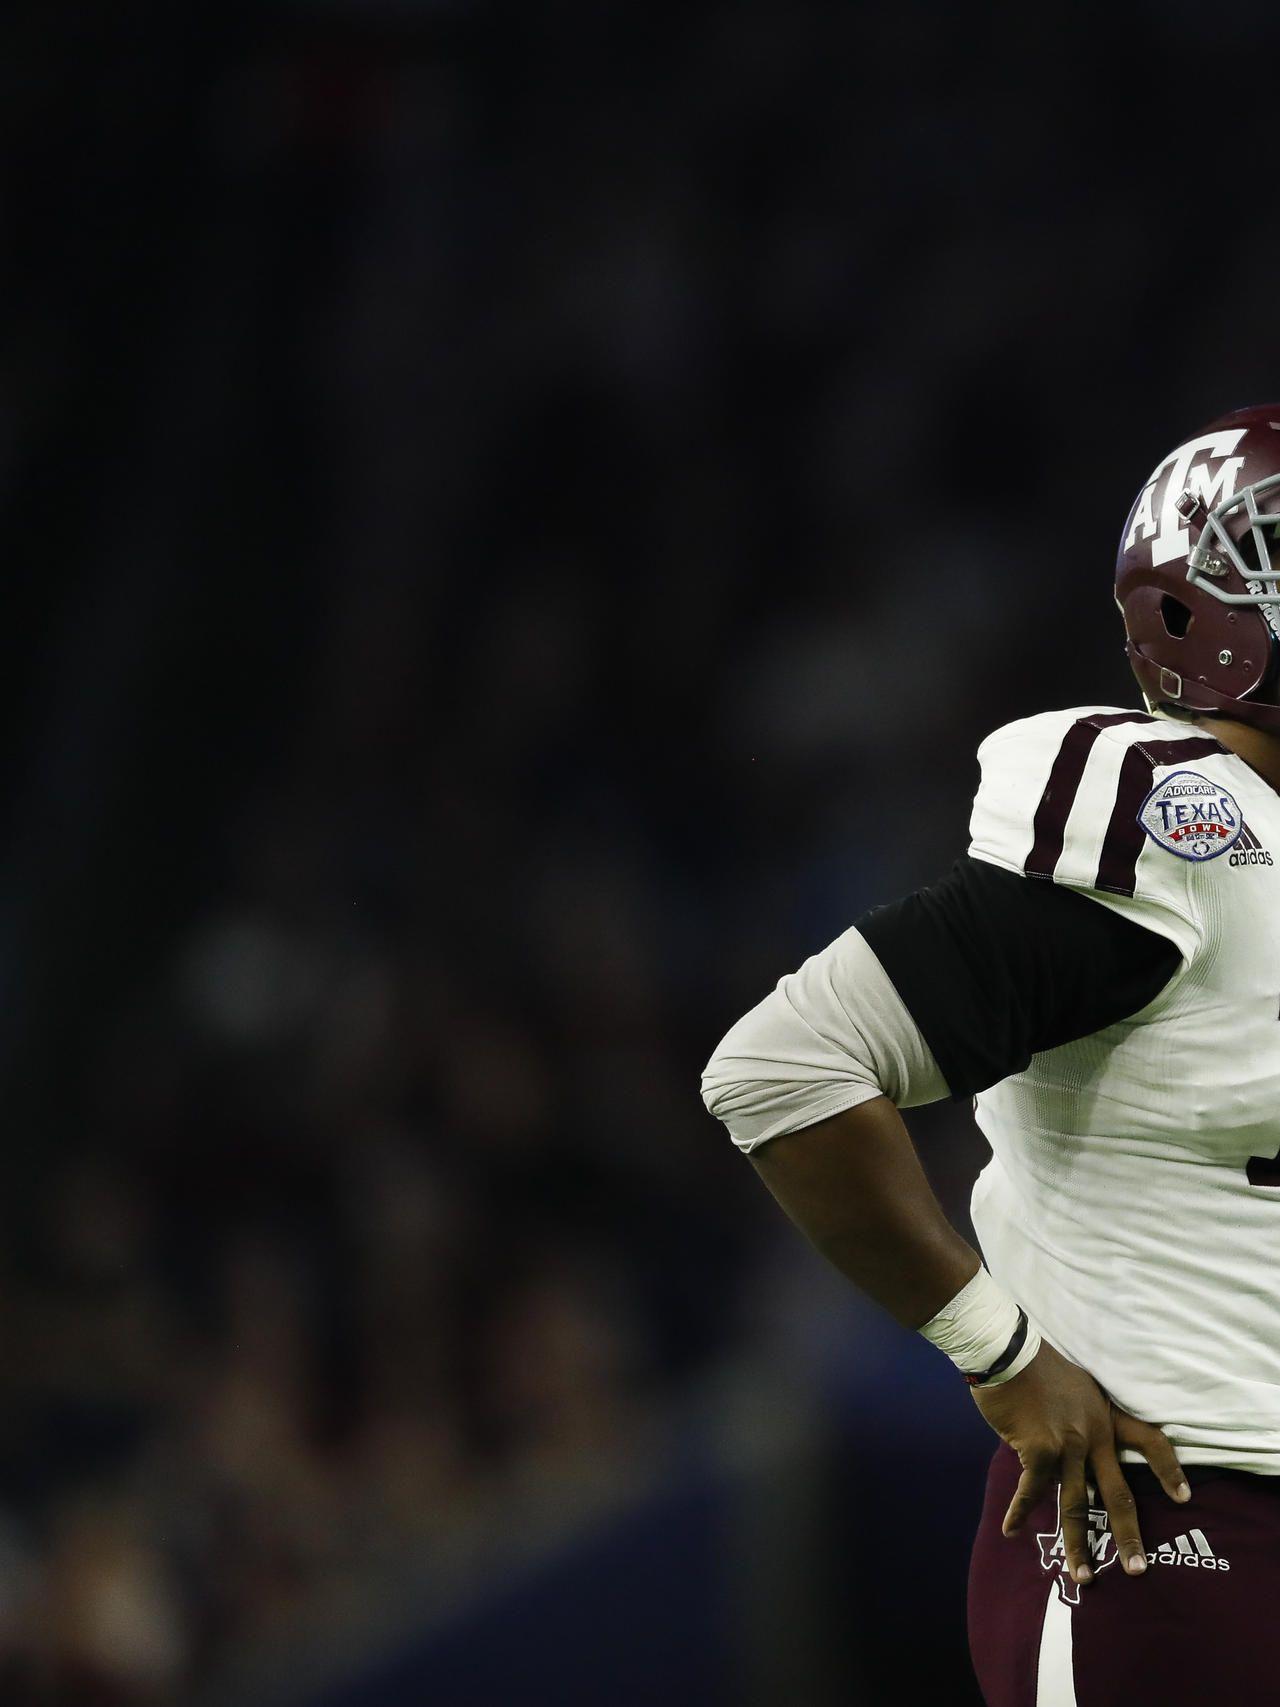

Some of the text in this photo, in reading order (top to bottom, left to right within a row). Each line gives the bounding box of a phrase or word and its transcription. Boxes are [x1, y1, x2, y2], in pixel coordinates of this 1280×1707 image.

[1163, 785, 1217, 798] ADVOCARE
[1156, 798, 1236, 831] TEXAS
[1179, 824, 1221, 835] BOWL
[1229, 849, 1273, 867] adidas
[1146, 1550, 1231, 1571] adidas
